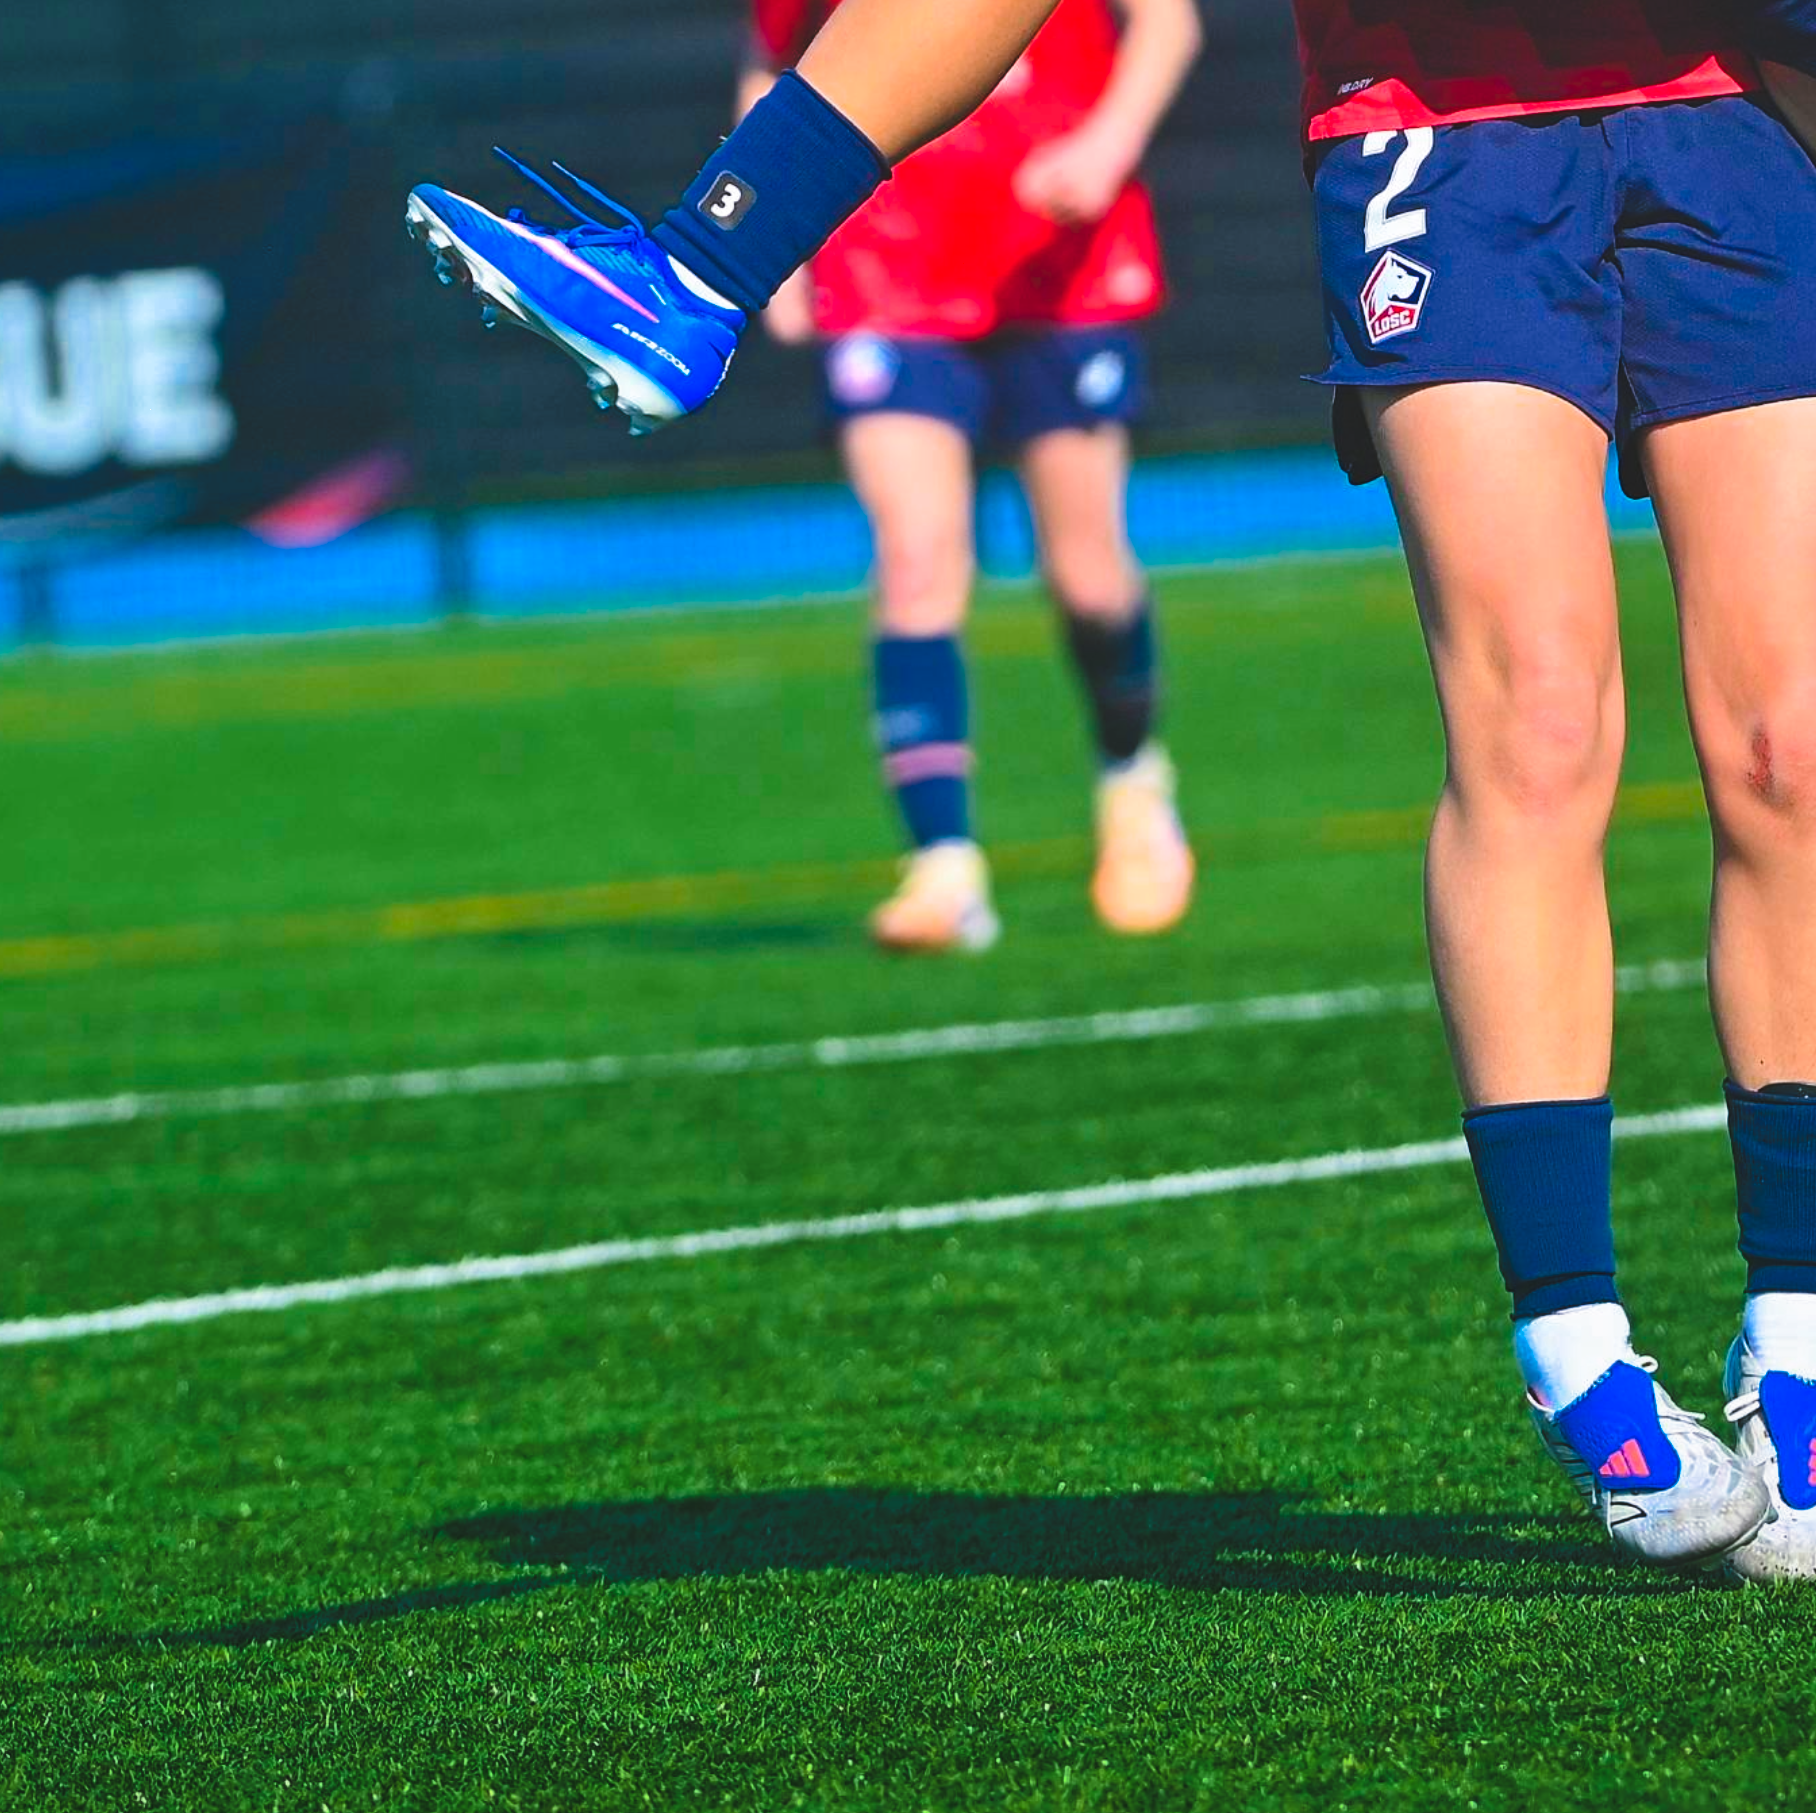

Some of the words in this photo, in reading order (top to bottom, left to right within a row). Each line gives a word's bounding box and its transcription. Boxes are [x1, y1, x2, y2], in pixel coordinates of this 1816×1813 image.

[710, 183, 742, 218] 3
[1362, 126, 1434, 254] 2
[1374, 310, 1411, 335] LOSC
